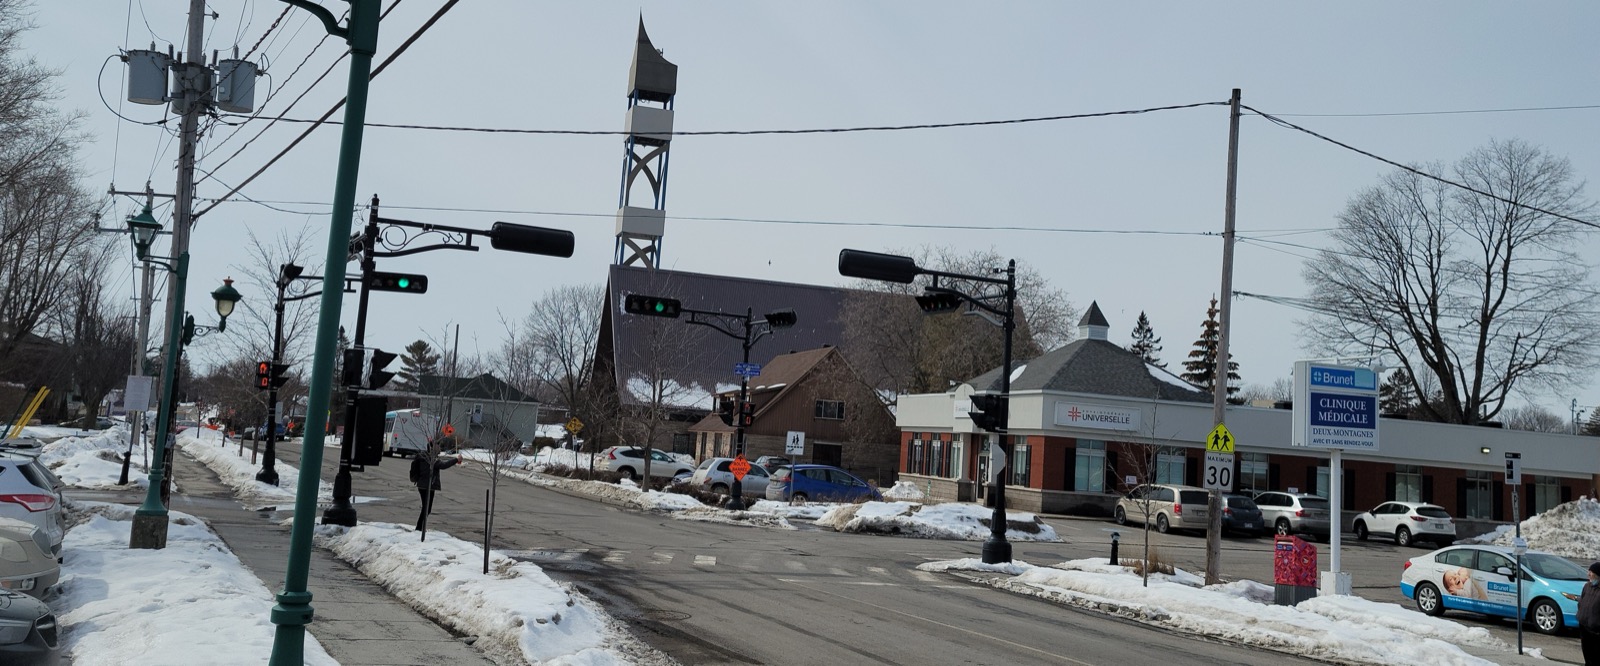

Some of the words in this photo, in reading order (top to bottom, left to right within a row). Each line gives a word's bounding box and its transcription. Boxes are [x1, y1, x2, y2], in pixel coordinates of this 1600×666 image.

[1323, 372, 1353, 386] Brunet
[1320, 398, 1366, 412] CLINIQUE
[1082, 413, 1131, 425] UNIVERSELLE
[1318, 410, 1368, 424] MÉDICALE
[1313, 427, 1374, 438] DEUX-MONTAGNES
[1207, 455, 1233, 463] MAXIMUM
[1207, 465, 1231, 487] 30
[1493, 583, 1509, 592] Brunet
